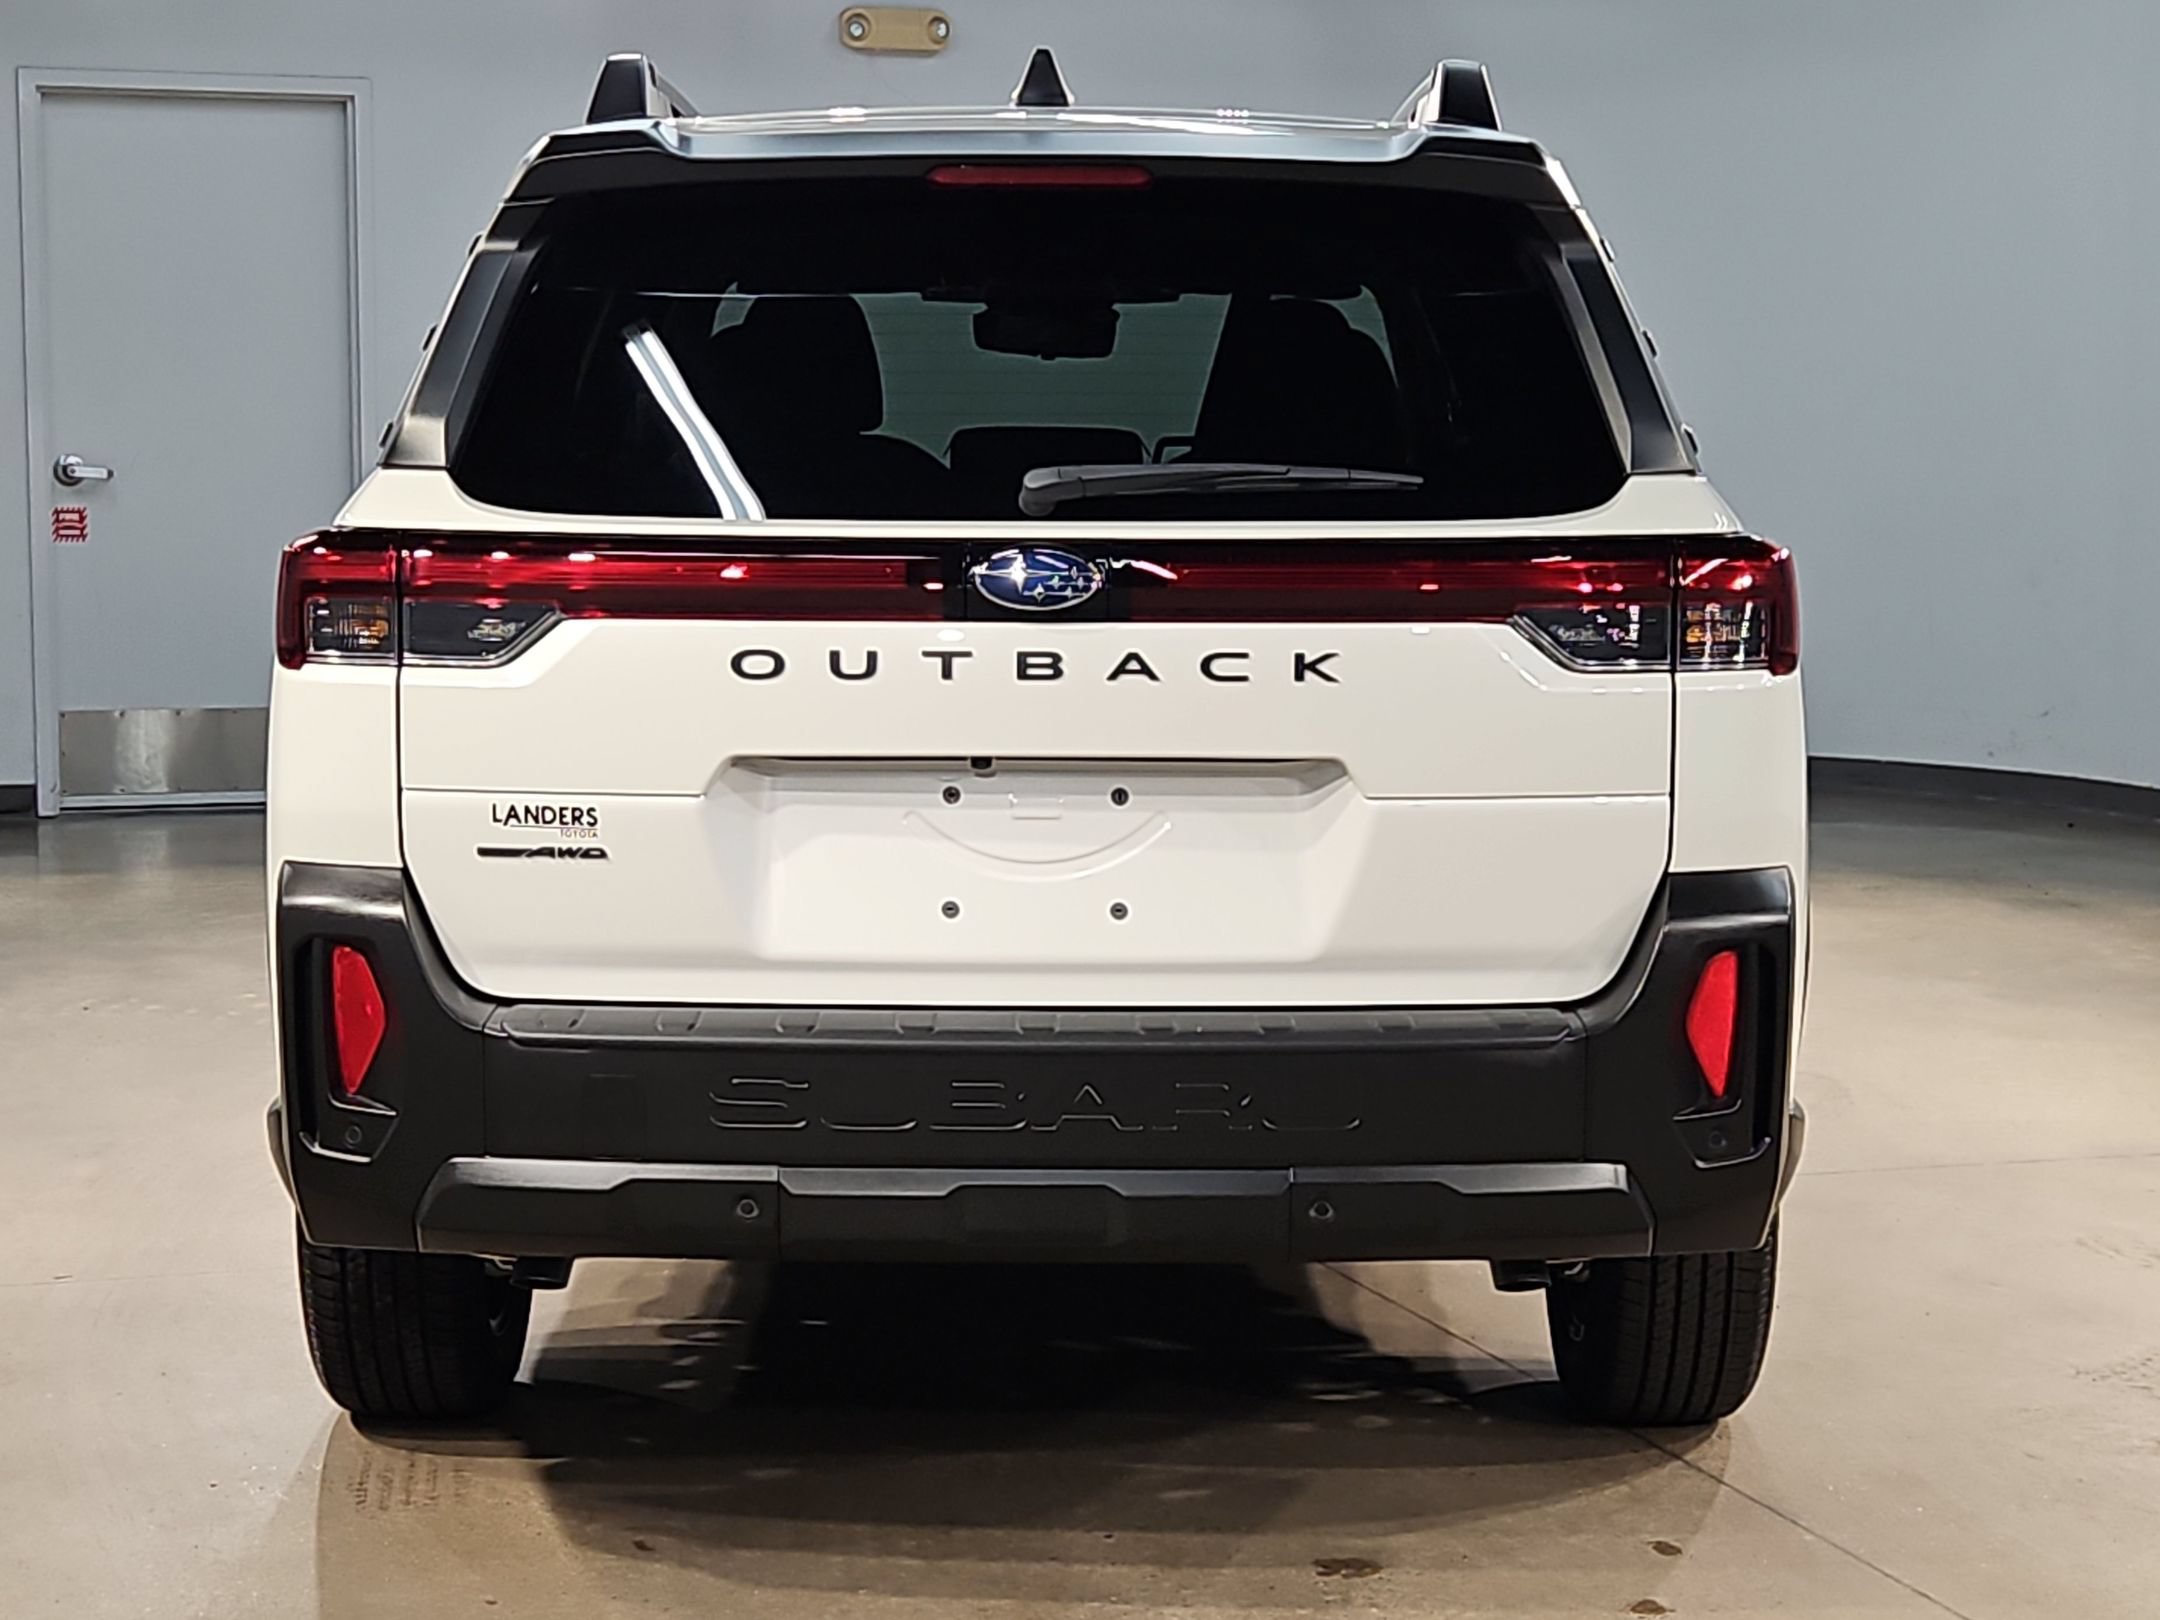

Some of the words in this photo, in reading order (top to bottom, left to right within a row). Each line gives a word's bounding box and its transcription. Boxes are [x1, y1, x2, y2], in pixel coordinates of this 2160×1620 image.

[730, 649, 1341, 683] OUTBACK
[492, 803, 598, 827] LANDERS
[559, 828, 598, 839] TOYOTA
[525, 847, 608, 859] AWD
[709, 1077, 1361, 1132] SUBARU
